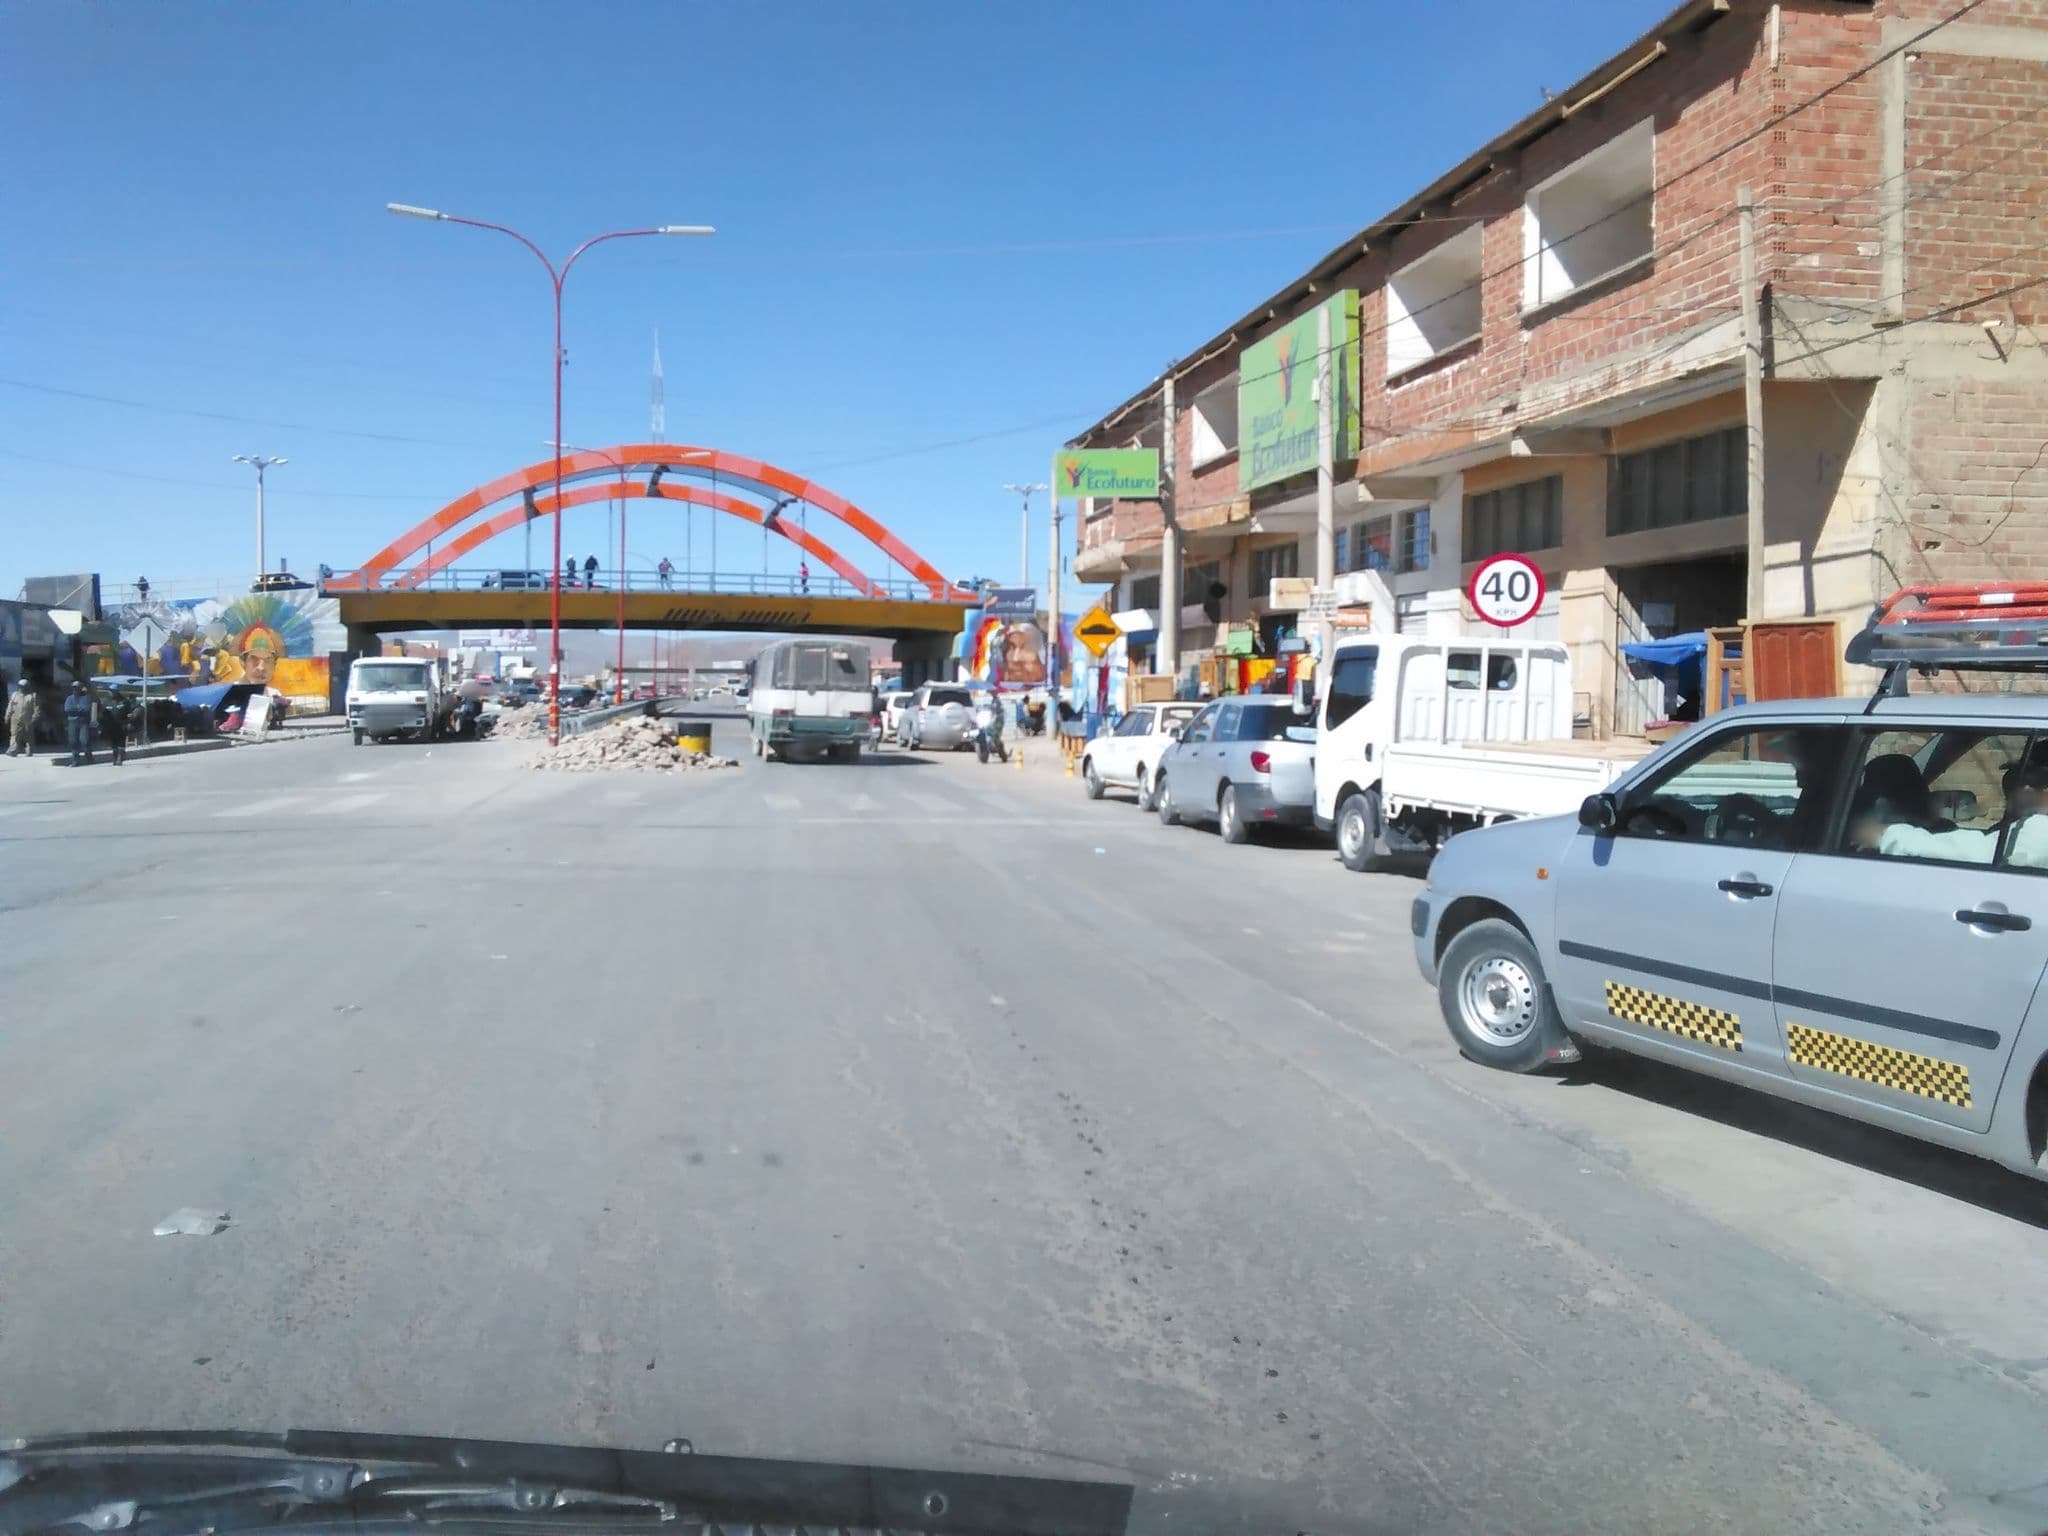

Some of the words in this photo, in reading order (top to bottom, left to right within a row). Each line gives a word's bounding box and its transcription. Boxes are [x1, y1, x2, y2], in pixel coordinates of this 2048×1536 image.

[1252, 424, 1318, 478] Ecofutur
[1086, 475, 1155, 490] Ecofuturo
[1481, 570, 1531, 602] 40
